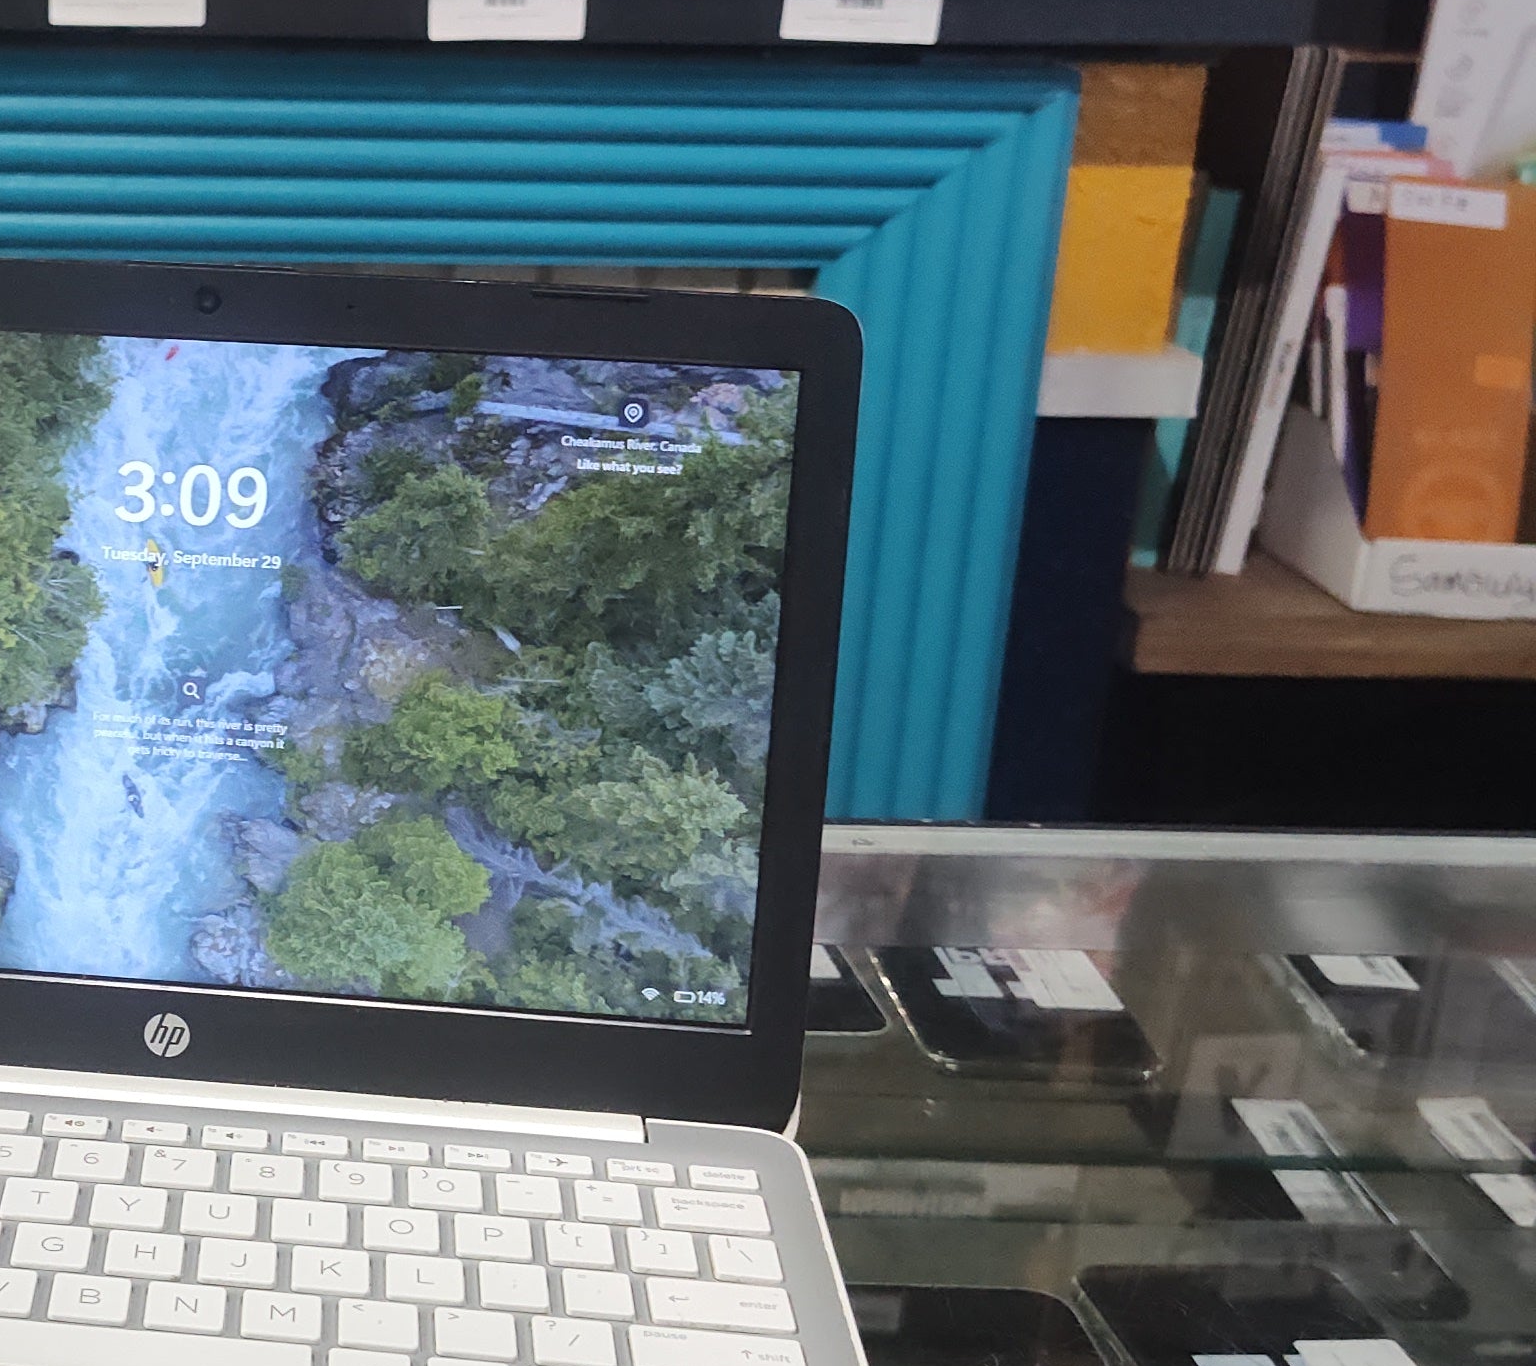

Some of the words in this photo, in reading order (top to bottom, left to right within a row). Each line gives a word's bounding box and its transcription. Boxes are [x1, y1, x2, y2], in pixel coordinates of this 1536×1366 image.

[659, 440, 702, 453] Canada
[577, 458, 600, 470] Like
[602, 461, 631, 472] what
[632, 464, 655, 475] you
[656, 464, 683, 475] see?
[114, 460, 269, 529] 3:09
[102, 546, 169, 566] Tuesday,
[173, 549, 258, 569] September
[261, 555, 282, 570] 29
[145, 1012, 190, 1058] hp
[31, 1190, 51, 1205] T
[119, 1196, 141, 1212] Y
[208, 1204, 231, 1220] U
[308, 1212, 312, 1227] I
[388, 1219, 415, 1235] O
[483, 1227, 504, 1242] P
